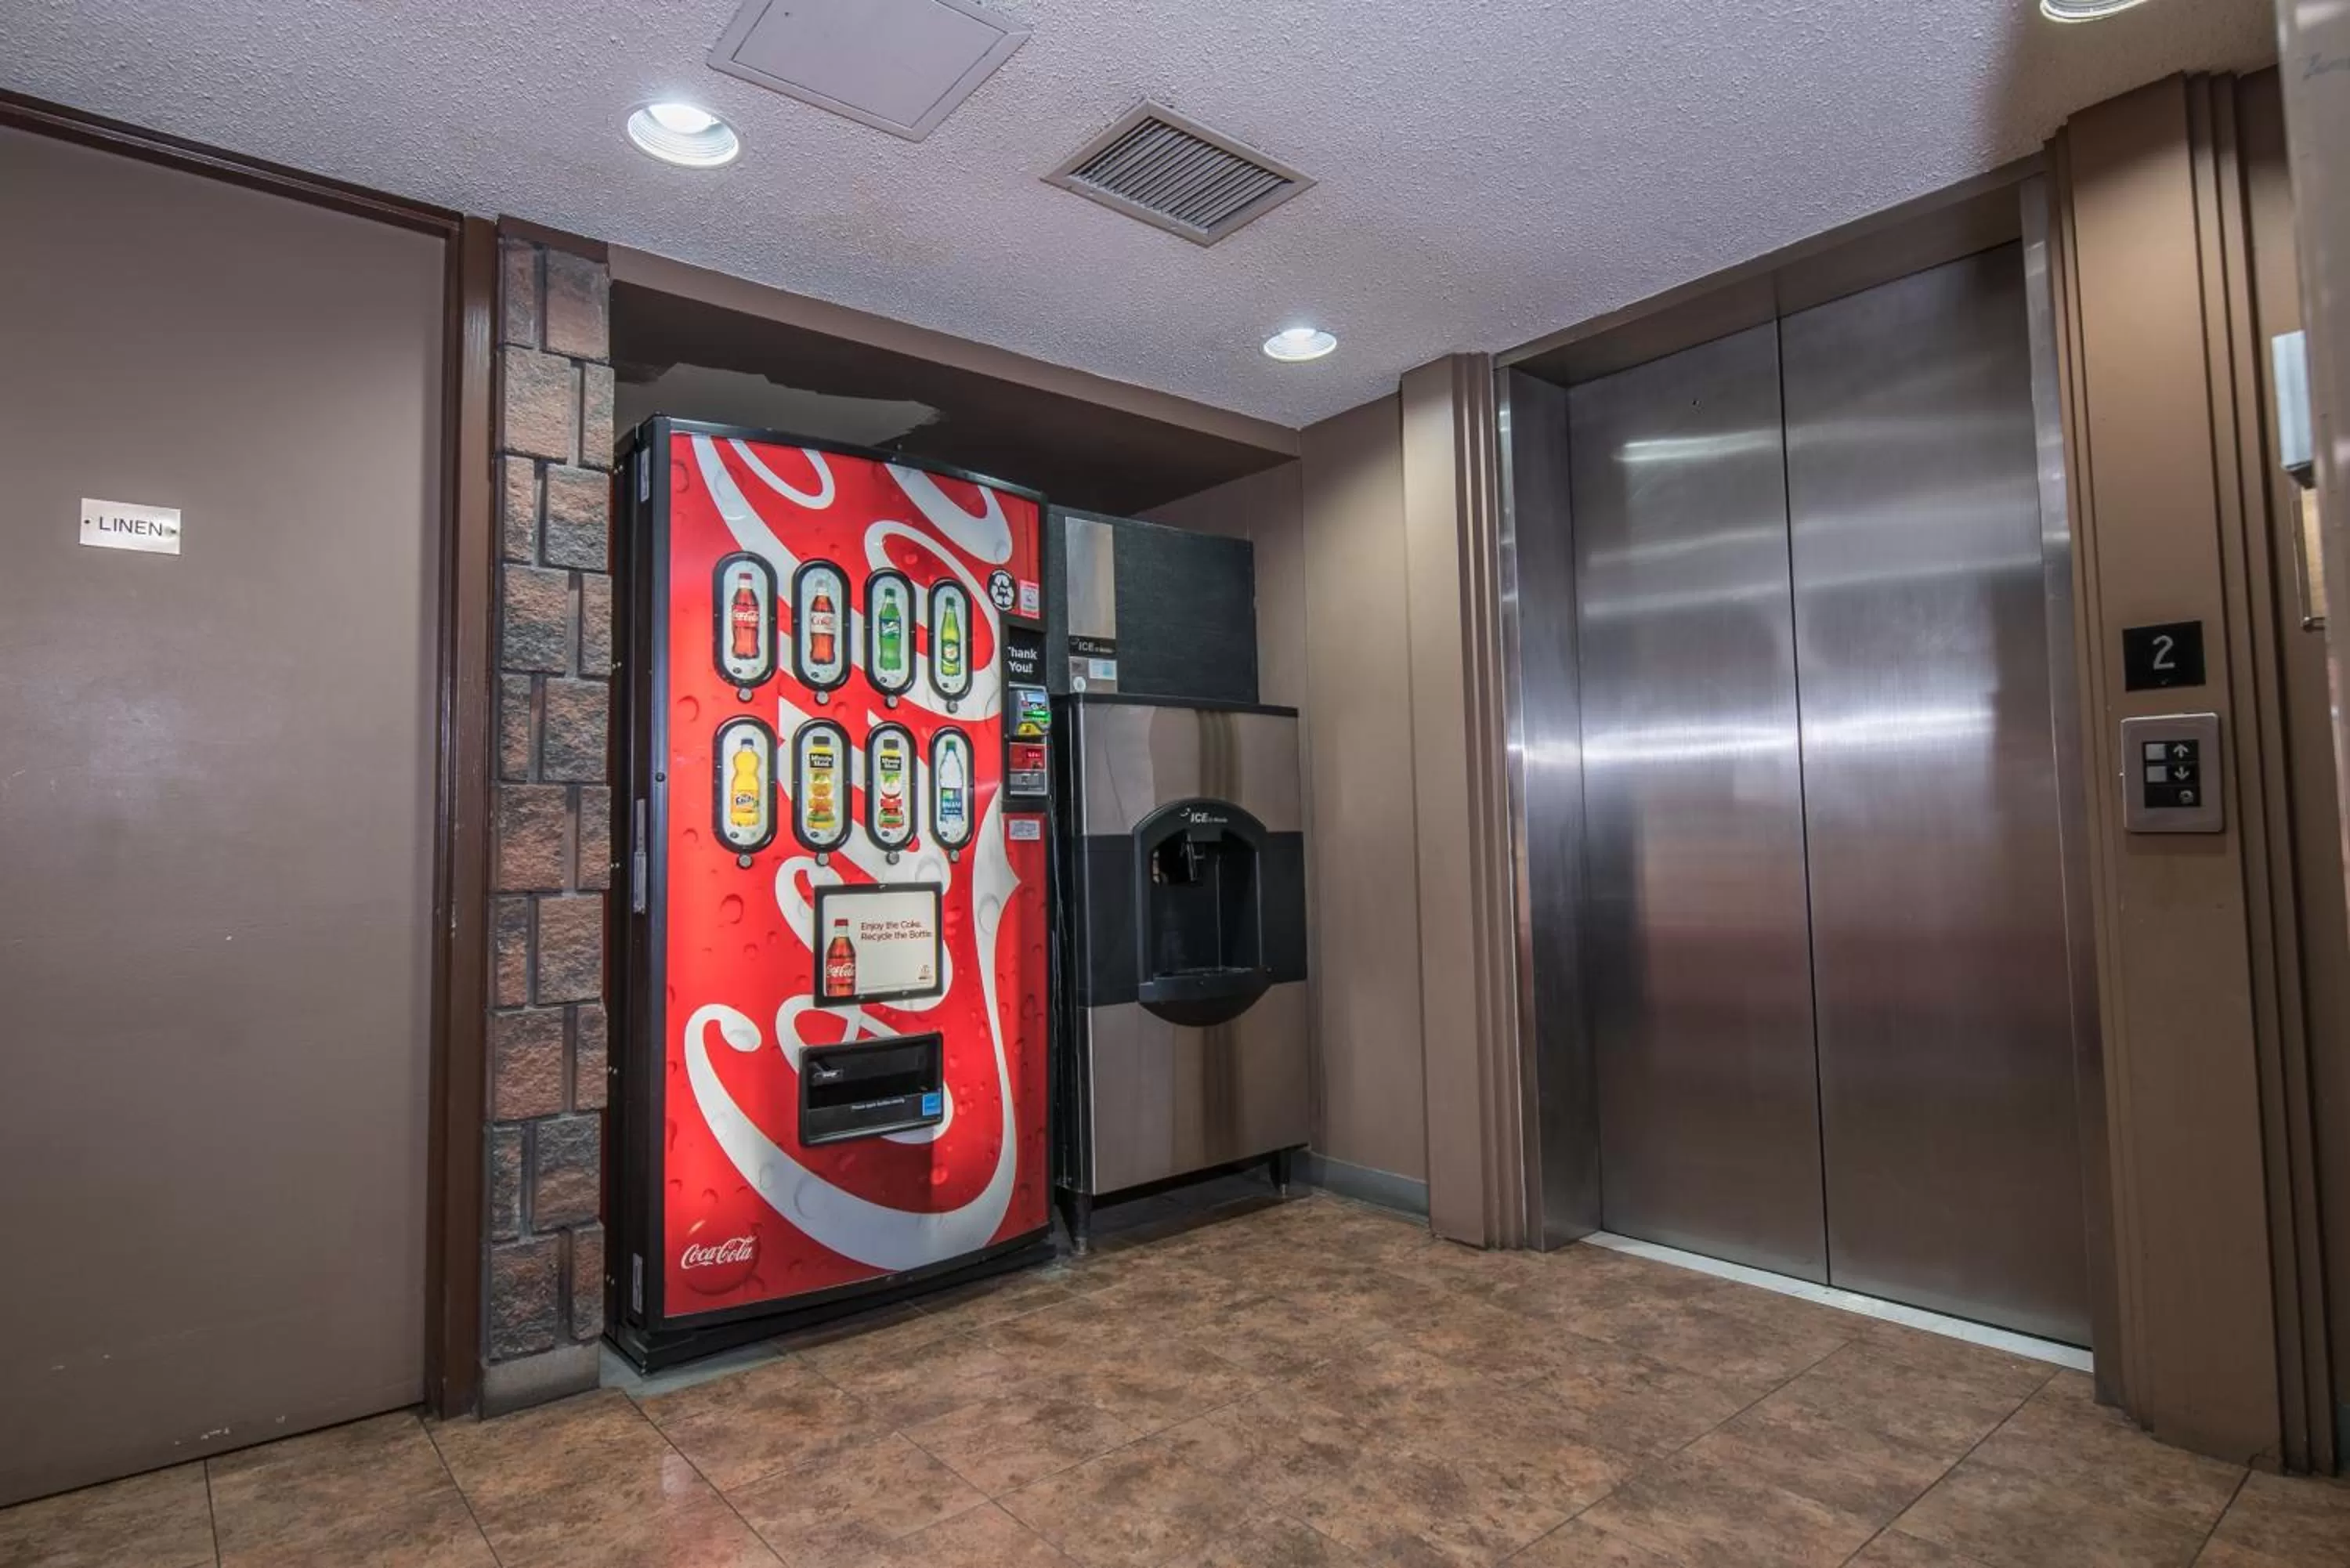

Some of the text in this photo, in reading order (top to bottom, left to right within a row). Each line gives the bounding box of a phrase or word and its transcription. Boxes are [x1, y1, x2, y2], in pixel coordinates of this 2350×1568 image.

[99, 516, 163, 536] LINEN
[1078, 641, 1094, 652] ICE
[2153, 635, 2175, 670] 2
[1008, 661, 1034, 673] You!
[1191, 812, 1209, 822] ICE
[861, 922, 884, 931] Enjoy
[886, 920, 898, 929] the
[861, 931, 892, 942] Recycle
[895, 930, 907, 939] the
[681, 1237, 756, 1269] Coca-Cola
